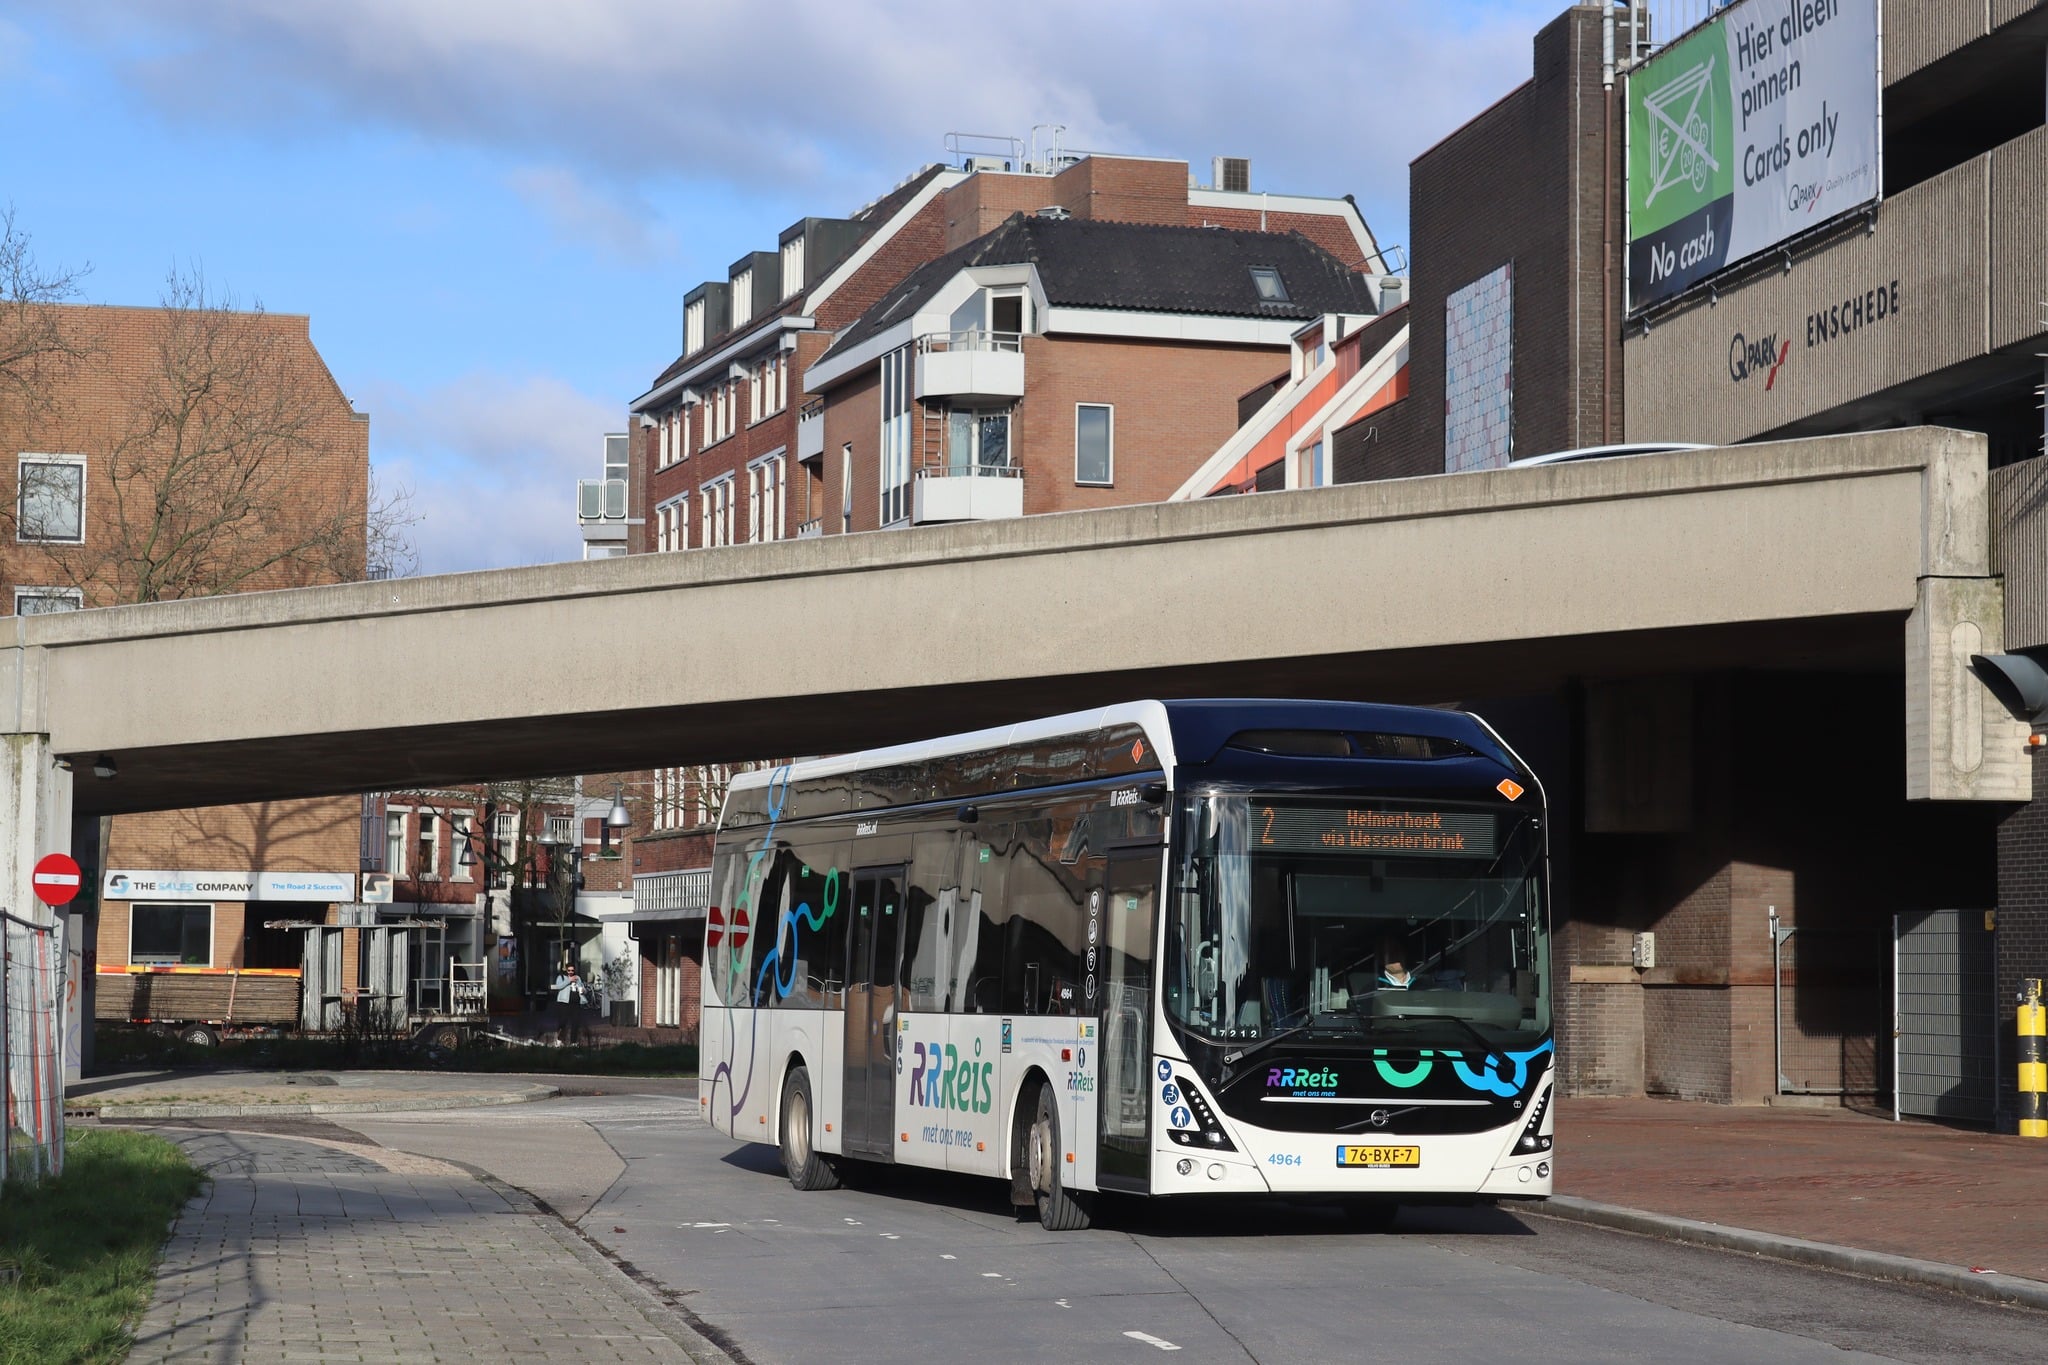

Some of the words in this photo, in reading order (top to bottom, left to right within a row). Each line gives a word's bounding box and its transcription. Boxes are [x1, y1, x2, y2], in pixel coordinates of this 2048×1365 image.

[1737, 22, 1774, 72] Hier
[1780, 0, 1838, 46] alleen
[1741, 60, 1801, 132] pinnen
[1743, 124, 1791, 187] Cards
[1797, 100, 1838, 159] only
[1650, 240, 1675, 284] No
[1680, 214, 1715, 270] cash
[1807, 280, 1899, 348] ENSCHEDE
[1262, 807, 1275, 844] 2
[1347, 809, 1442, 829] Helmerhoek
[1321, 829, 1345, 847] via
[1350, 830, 1465, 850] Wesselerbrink
[133, 881, 156, 890] THE
[158, 882, 194, 891] SALES
[196, 883, 254, 892] COMPANY
[313, 883, 343, 891] Success
[909, 1037, 993, 1114] RRReis
[1067, 1070, 1094, 1092] RRReis
[1267, 1066, 1339, 1087] RRReis
[922, 1123, 939, 1141] met
[939, 1130, 954, 1146] ons
[954, 1129, 973, 1148] mee
[1267, 1154, 1303, 1166] 4964
[1350, 1149, 1413, 1162] 76-BXF-7
